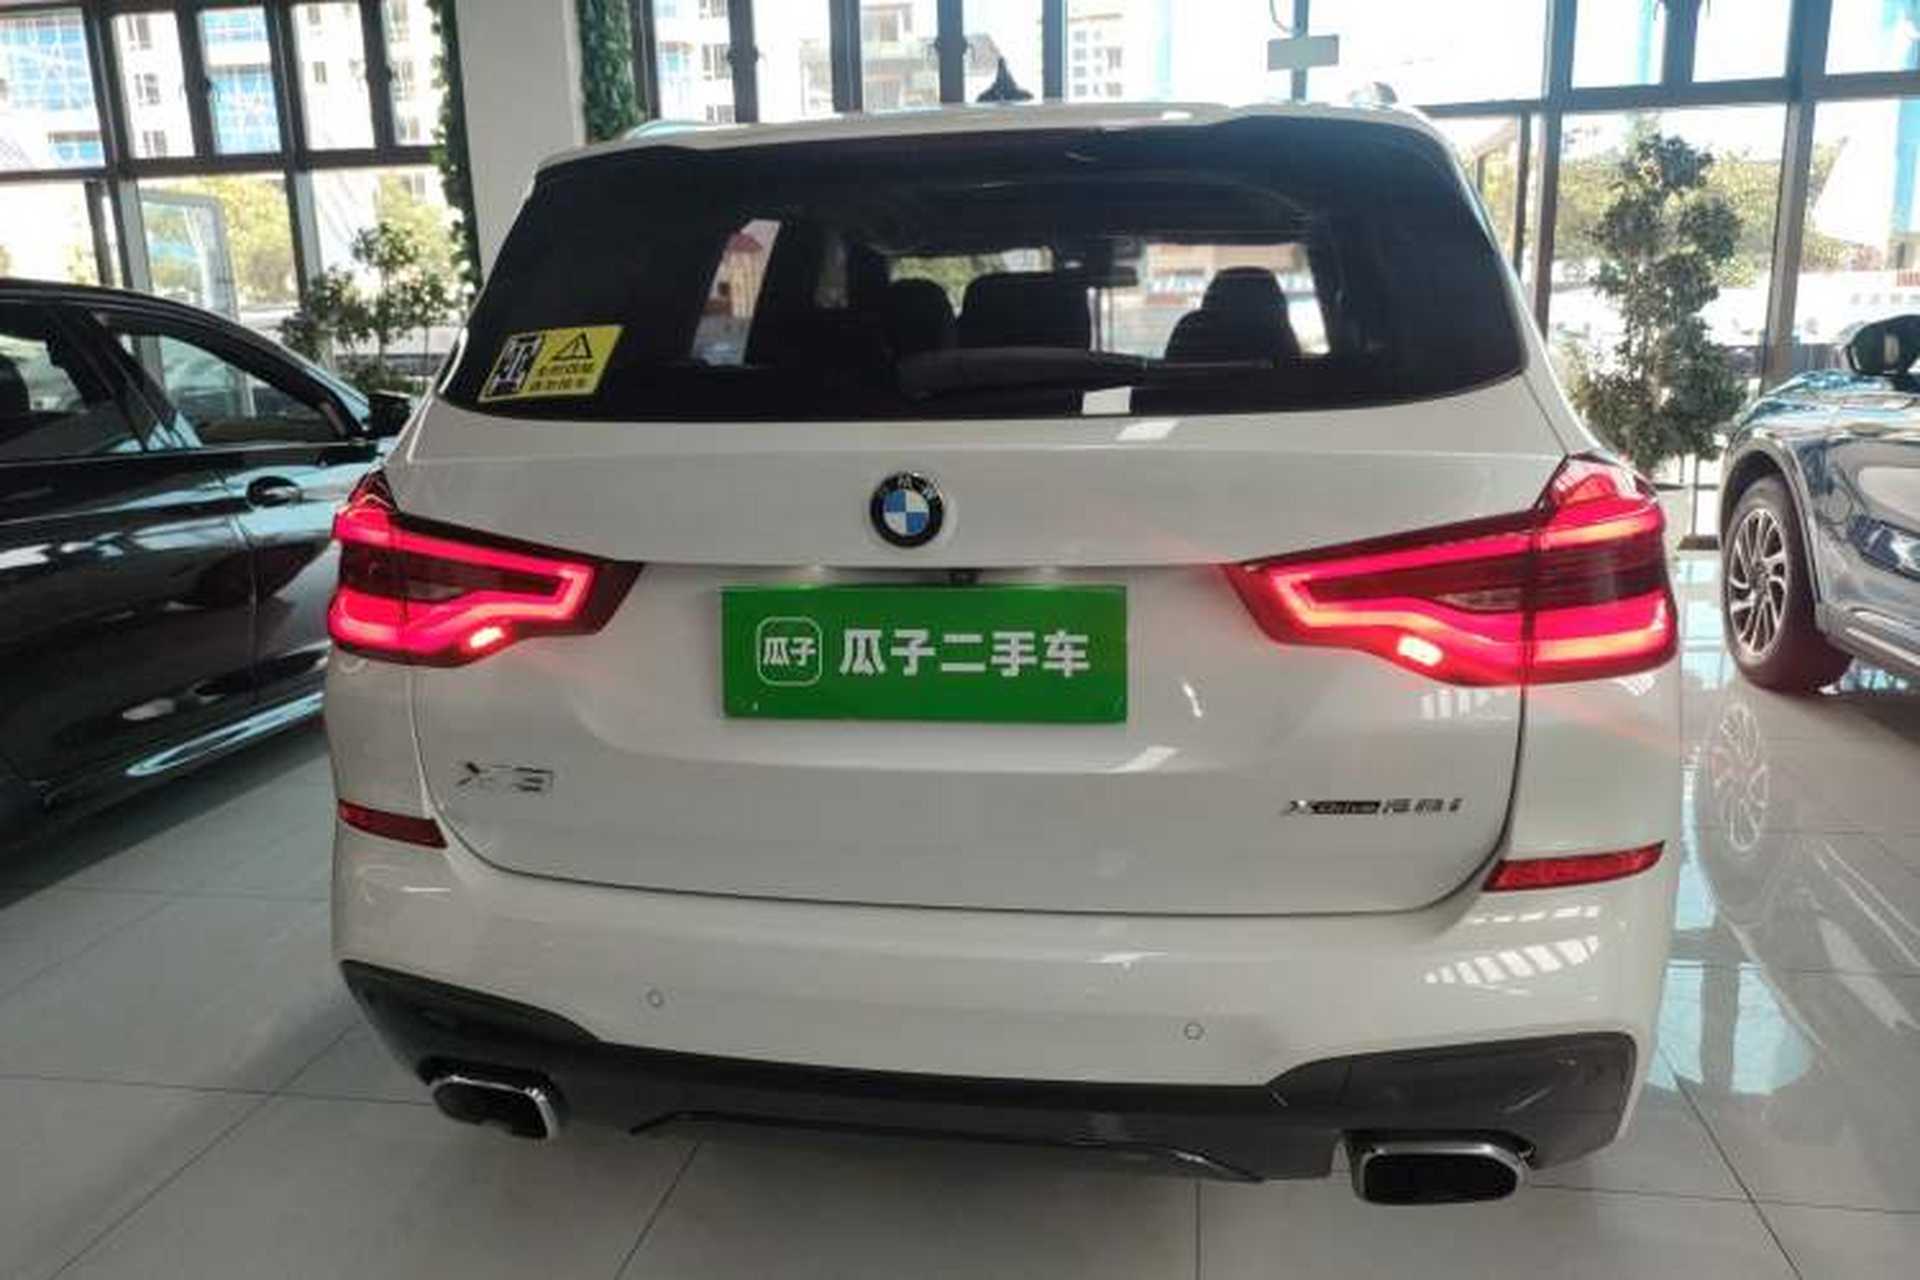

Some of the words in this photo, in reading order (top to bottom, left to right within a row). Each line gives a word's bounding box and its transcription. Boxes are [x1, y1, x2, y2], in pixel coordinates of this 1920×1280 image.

[762, 636, 817, 667] 瓜子
[839, 628, 1092, 678] 瓜子二手车
